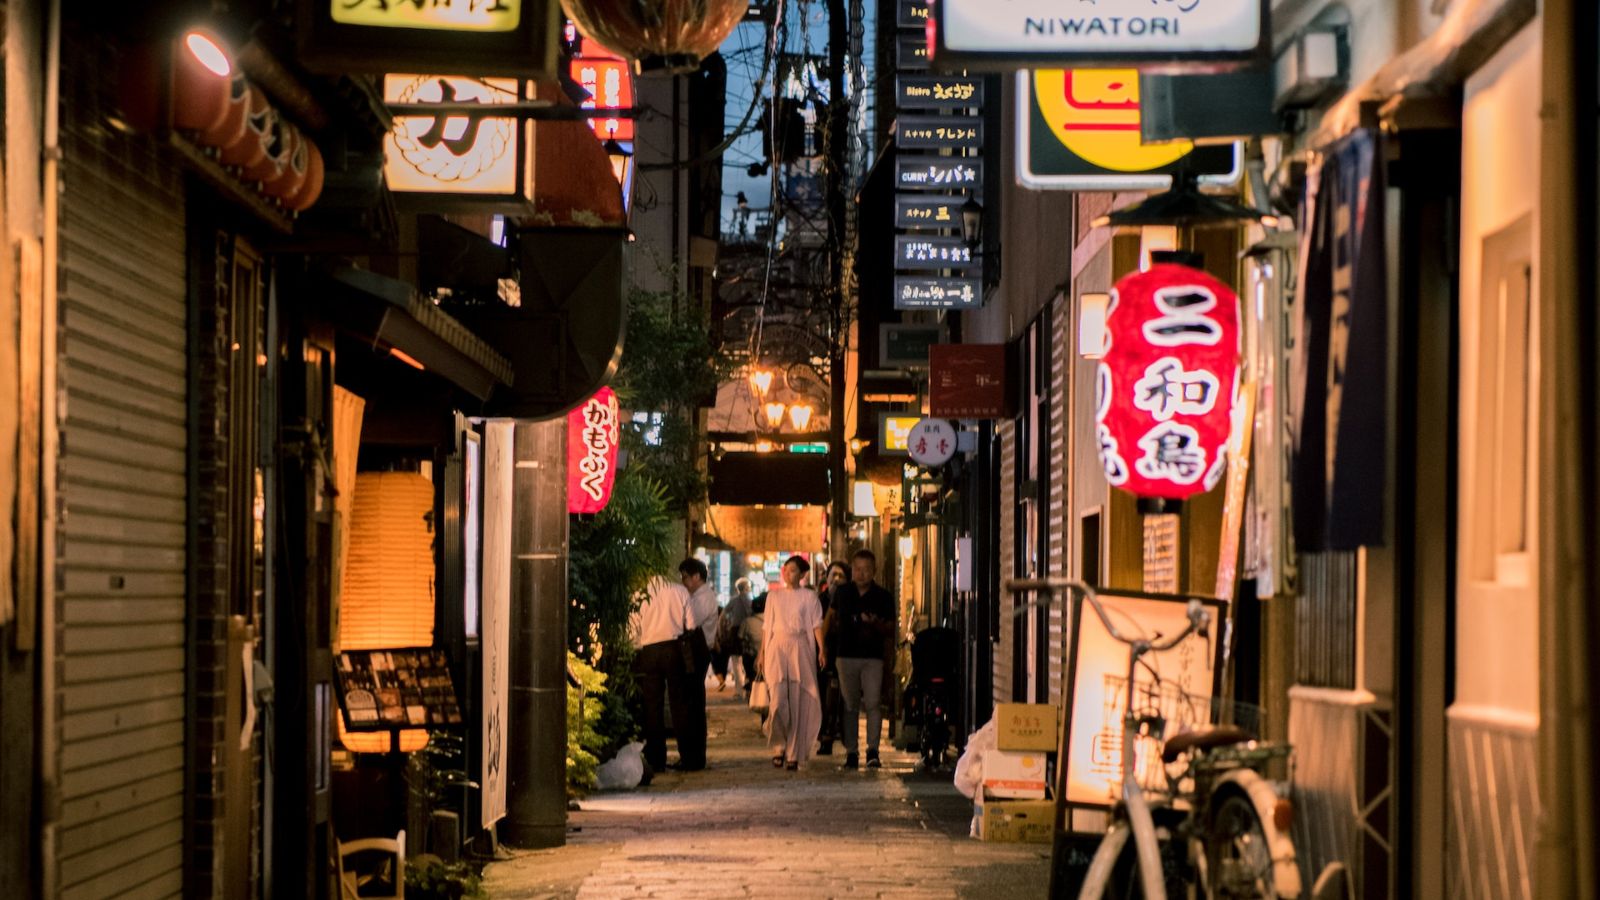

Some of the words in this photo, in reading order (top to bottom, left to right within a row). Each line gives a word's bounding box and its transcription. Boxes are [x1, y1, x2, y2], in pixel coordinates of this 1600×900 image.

[1023, 17, 1179, 36] NIWATORI
[906, 86, 931, 96] Bistro
[936, 127, 977, 140] フレンド
[901, 172, 928, 182] CURRY
[1134, 285, 1224, 485] 二和鳥
[579, 398, 610, 502] かもふく
